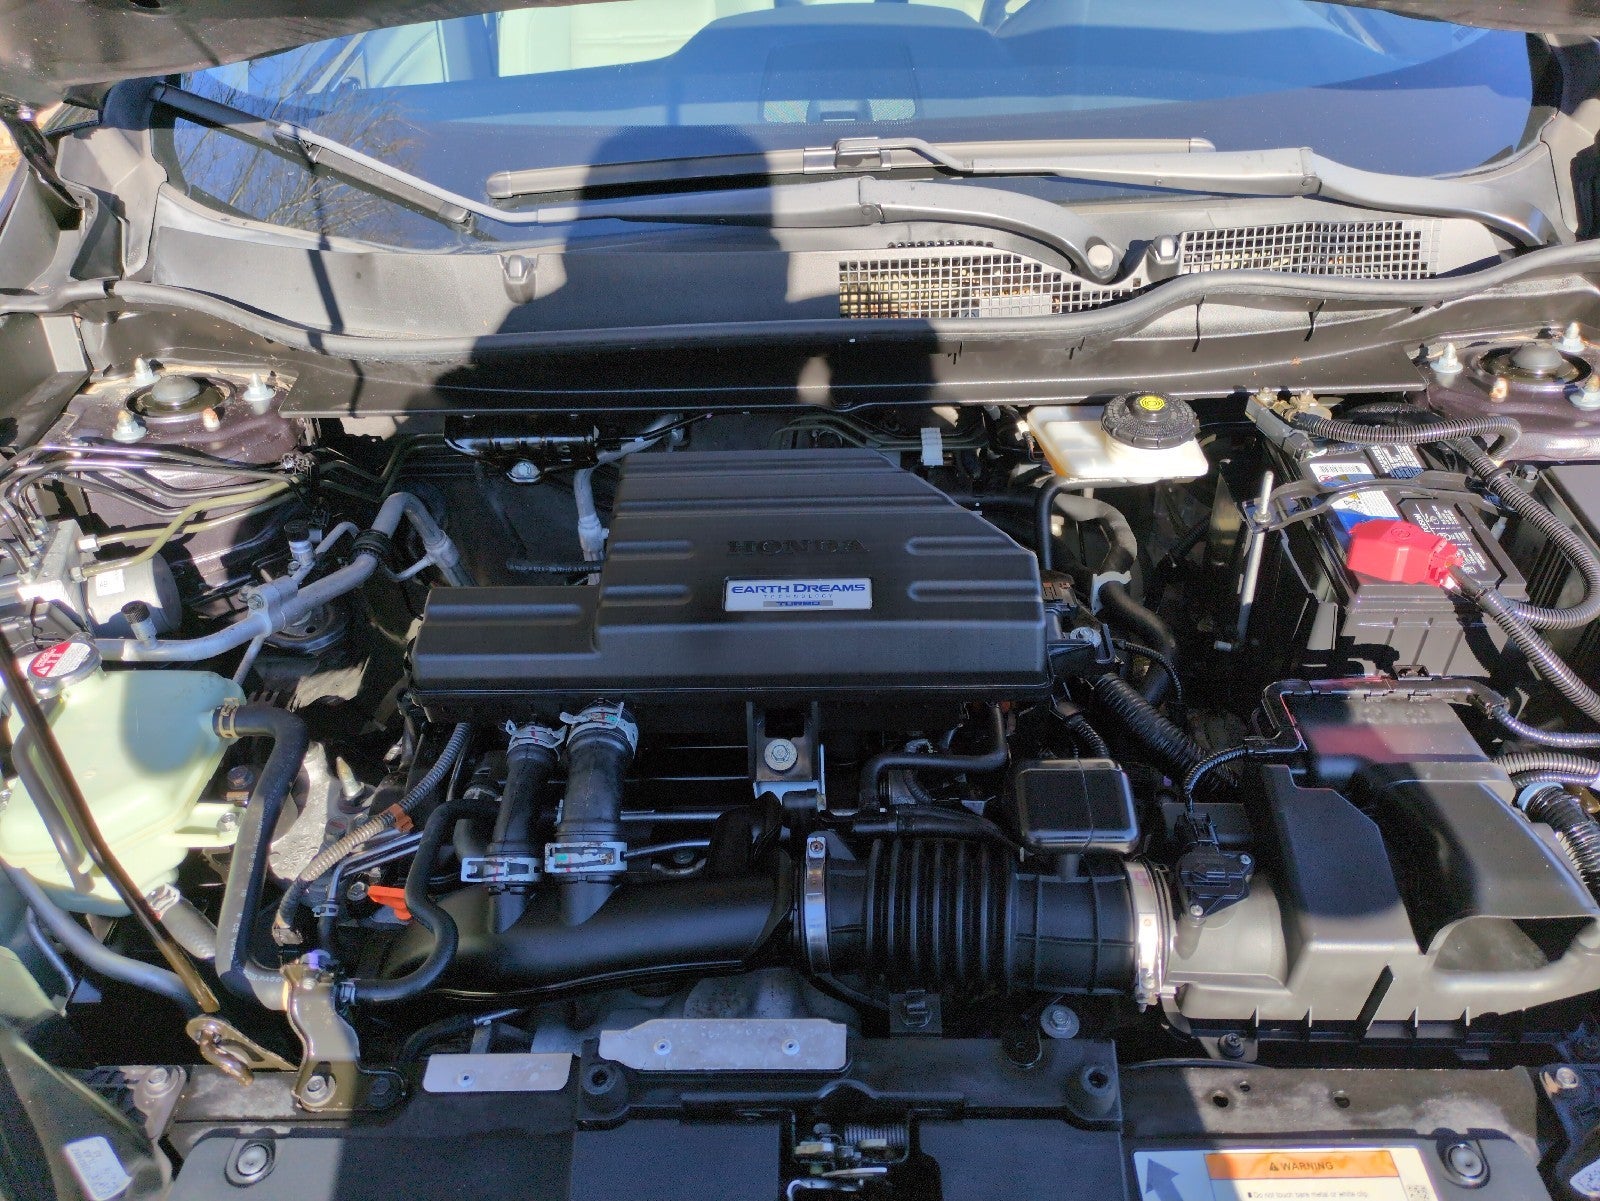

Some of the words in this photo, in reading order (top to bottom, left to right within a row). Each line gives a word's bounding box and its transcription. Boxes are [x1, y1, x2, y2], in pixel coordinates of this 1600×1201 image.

[727, 539, 870, 553] HONDA
[731, 585, 790, 594] EARTH
[793, 583, 866, 593] DREAMS
[1282, 1162, 1333, 1171] WARNING
